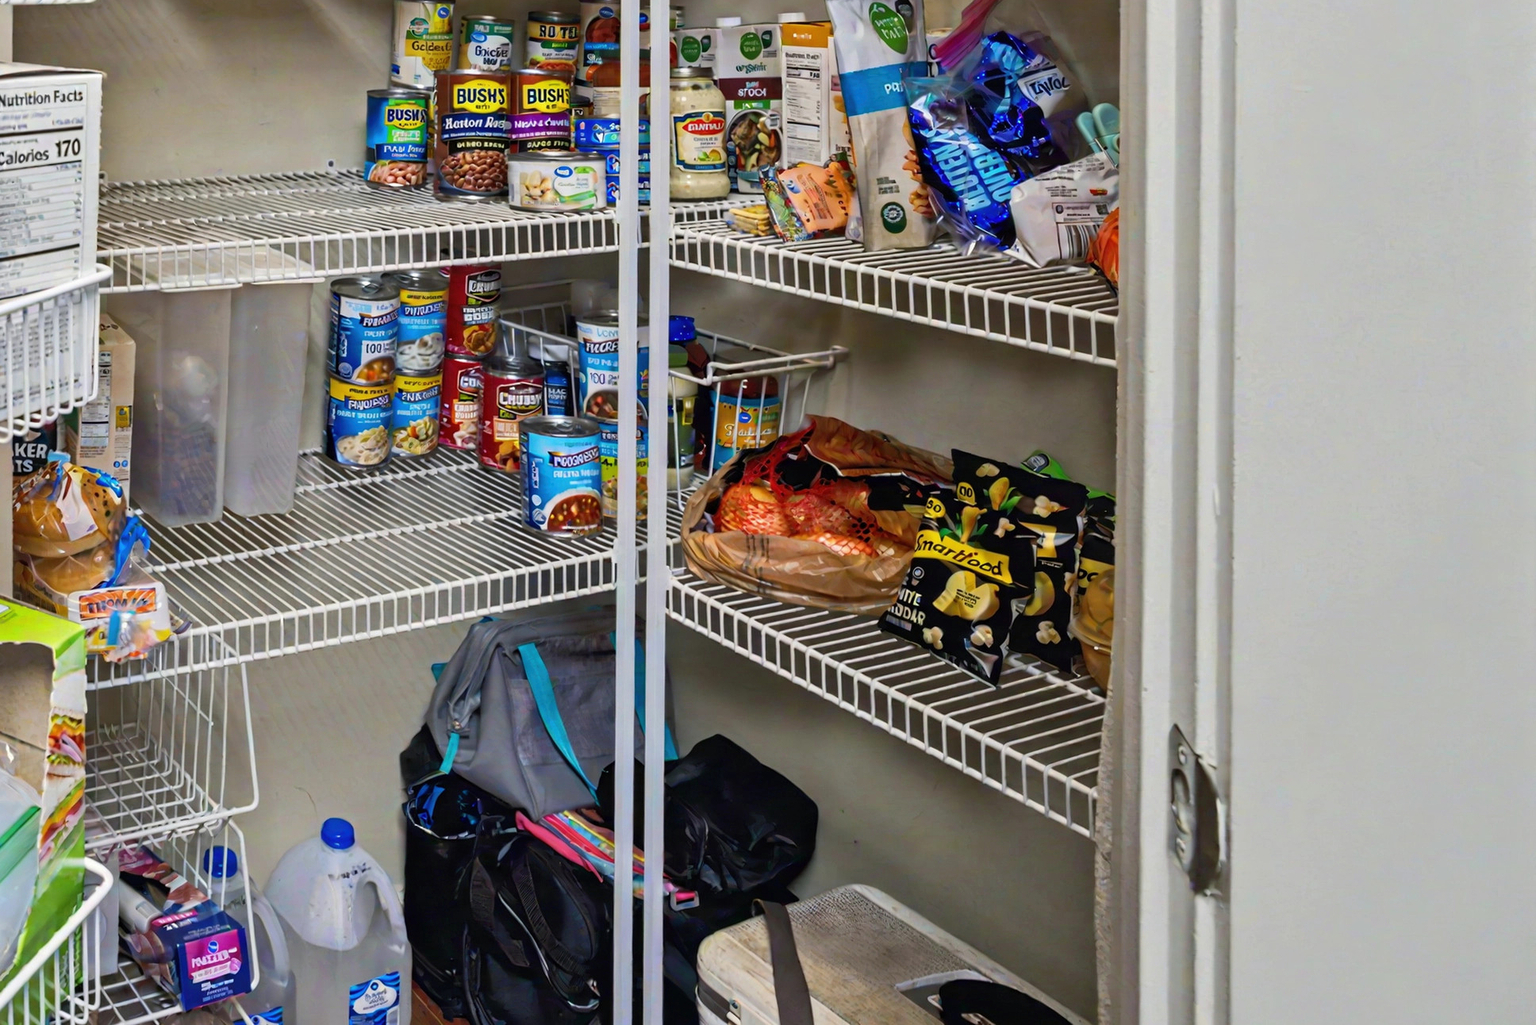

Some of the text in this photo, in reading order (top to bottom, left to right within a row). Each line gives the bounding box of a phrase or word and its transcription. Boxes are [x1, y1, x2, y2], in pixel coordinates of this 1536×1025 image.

[53, 89, 84, 104] Facts
[55, 137, 82, 158] 170
[15, 442, 48, 459] KER
[914, 533, 1004, 576] Smartfood
